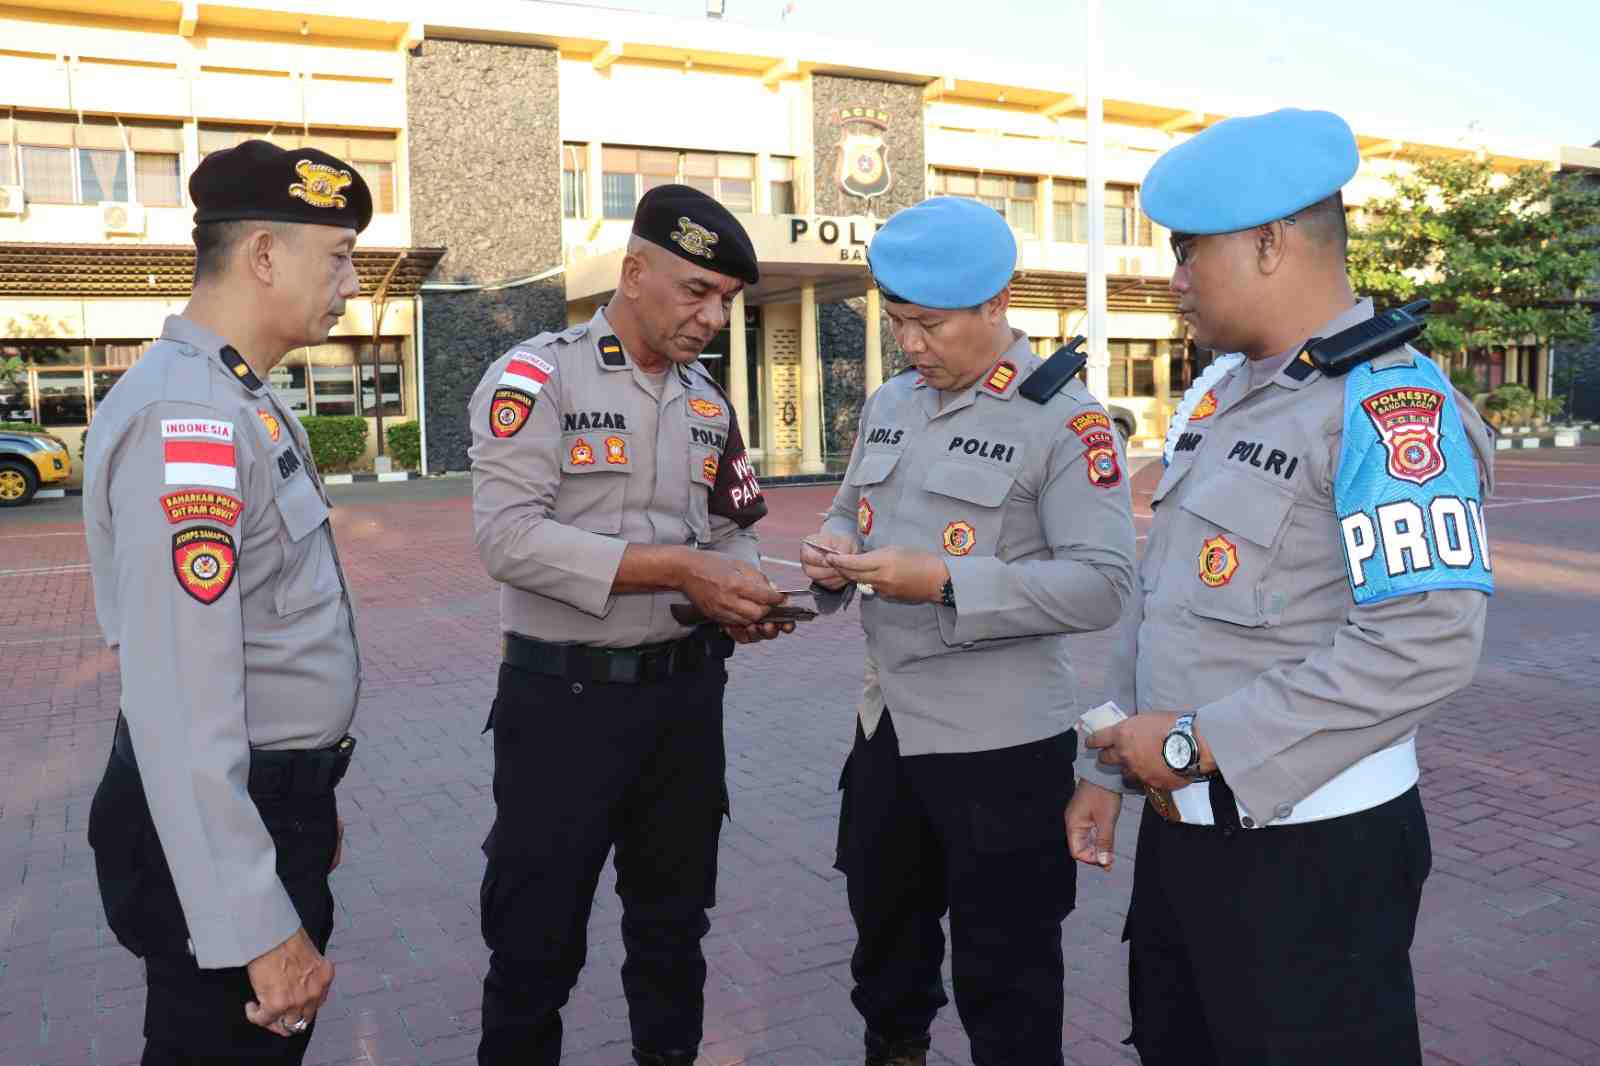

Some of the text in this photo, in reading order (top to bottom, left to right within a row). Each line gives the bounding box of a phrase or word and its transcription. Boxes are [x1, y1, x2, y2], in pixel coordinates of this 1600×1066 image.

[840, 106, 889, 121] ACEH
[790, 219, 882, 245] POL
[840, 249, 862, 261] BA
[1371, 391, 1437, 409] POLRESTA
[166, 423, 230, 437] INDONESIA
[564, 412, 626, 432] NAZAR
[948, 436, 1016, 463] POLRI
[1228, 441, 1298, 479] POLRI
[187, 505, 208, 514] PAM
